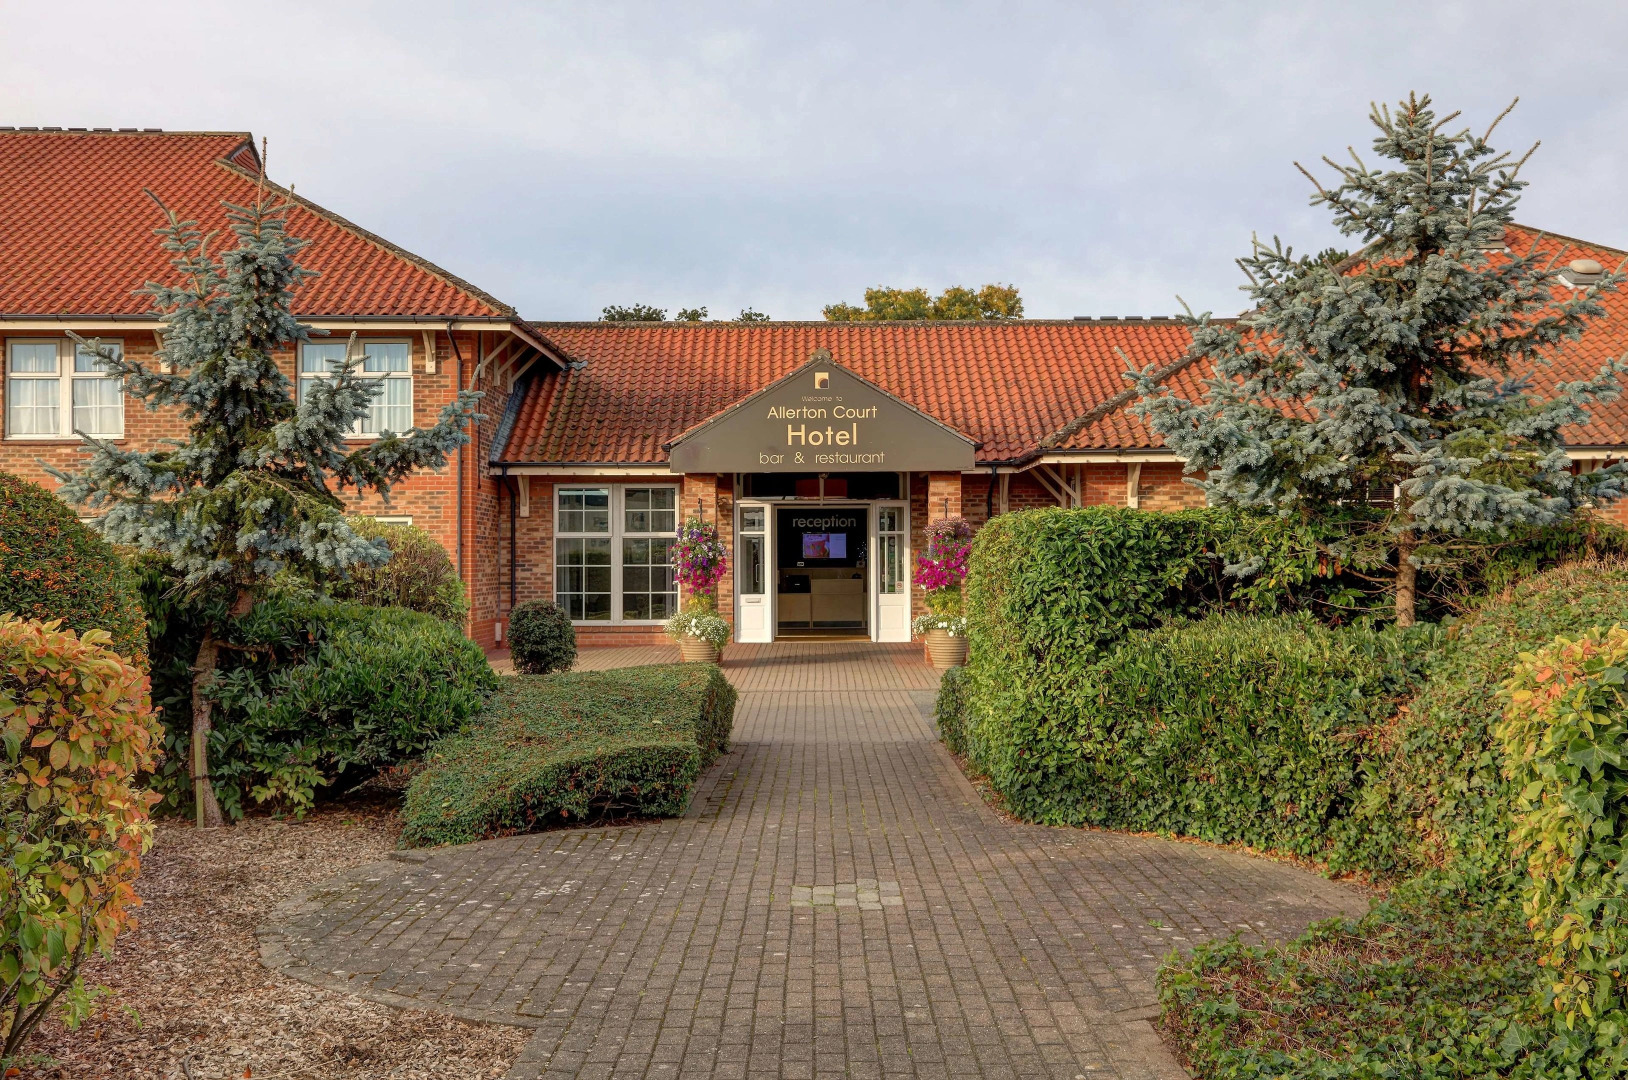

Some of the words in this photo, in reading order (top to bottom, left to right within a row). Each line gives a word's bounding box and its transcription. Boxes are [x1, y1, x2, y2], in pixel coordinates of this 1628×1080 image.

[767, 406, 827, 419] Allerton
[833, 405, 878, 419] Court
[787, 422, 857, 446] Hotel
[759, 452, 785, 464] bar
[794, 451, 805, 464] &
[815, 451, 886, 464] restaurant
[792, 514, 857, 531] reception
